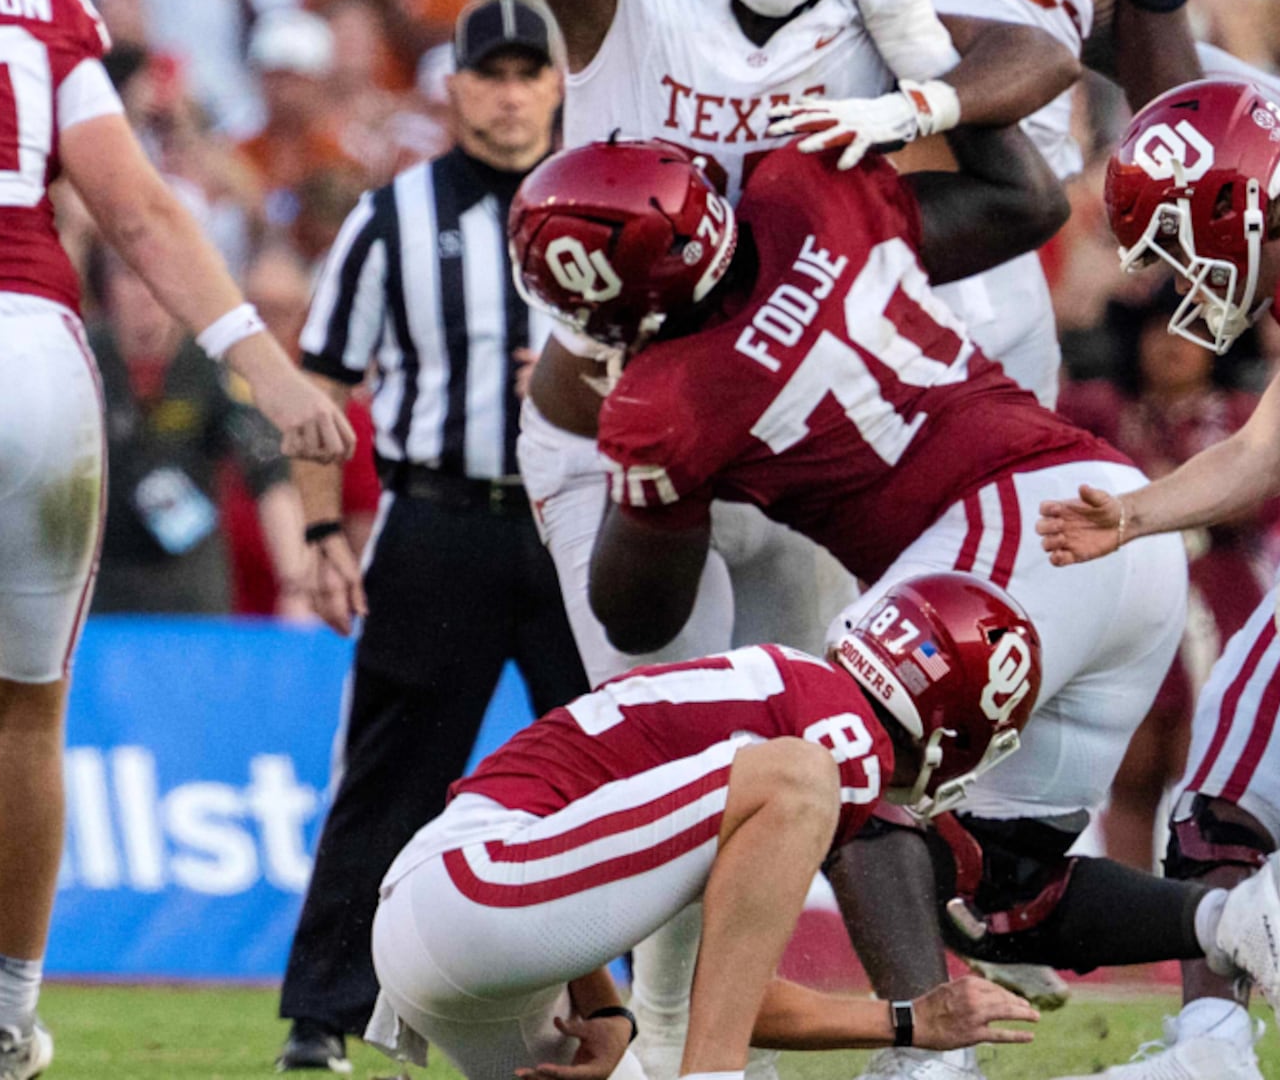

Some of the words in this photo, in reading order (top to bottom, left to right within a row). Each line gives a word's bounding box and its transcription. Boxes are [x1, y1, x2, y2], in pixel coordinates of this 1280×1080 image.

[660, 74, 826, 144] TEX
[734, 234, 850, 374] FODJE
[750, 236, 977, 468] 70
[869, 605, 920, 655] 87
[803, 712, 882, 805] 87
